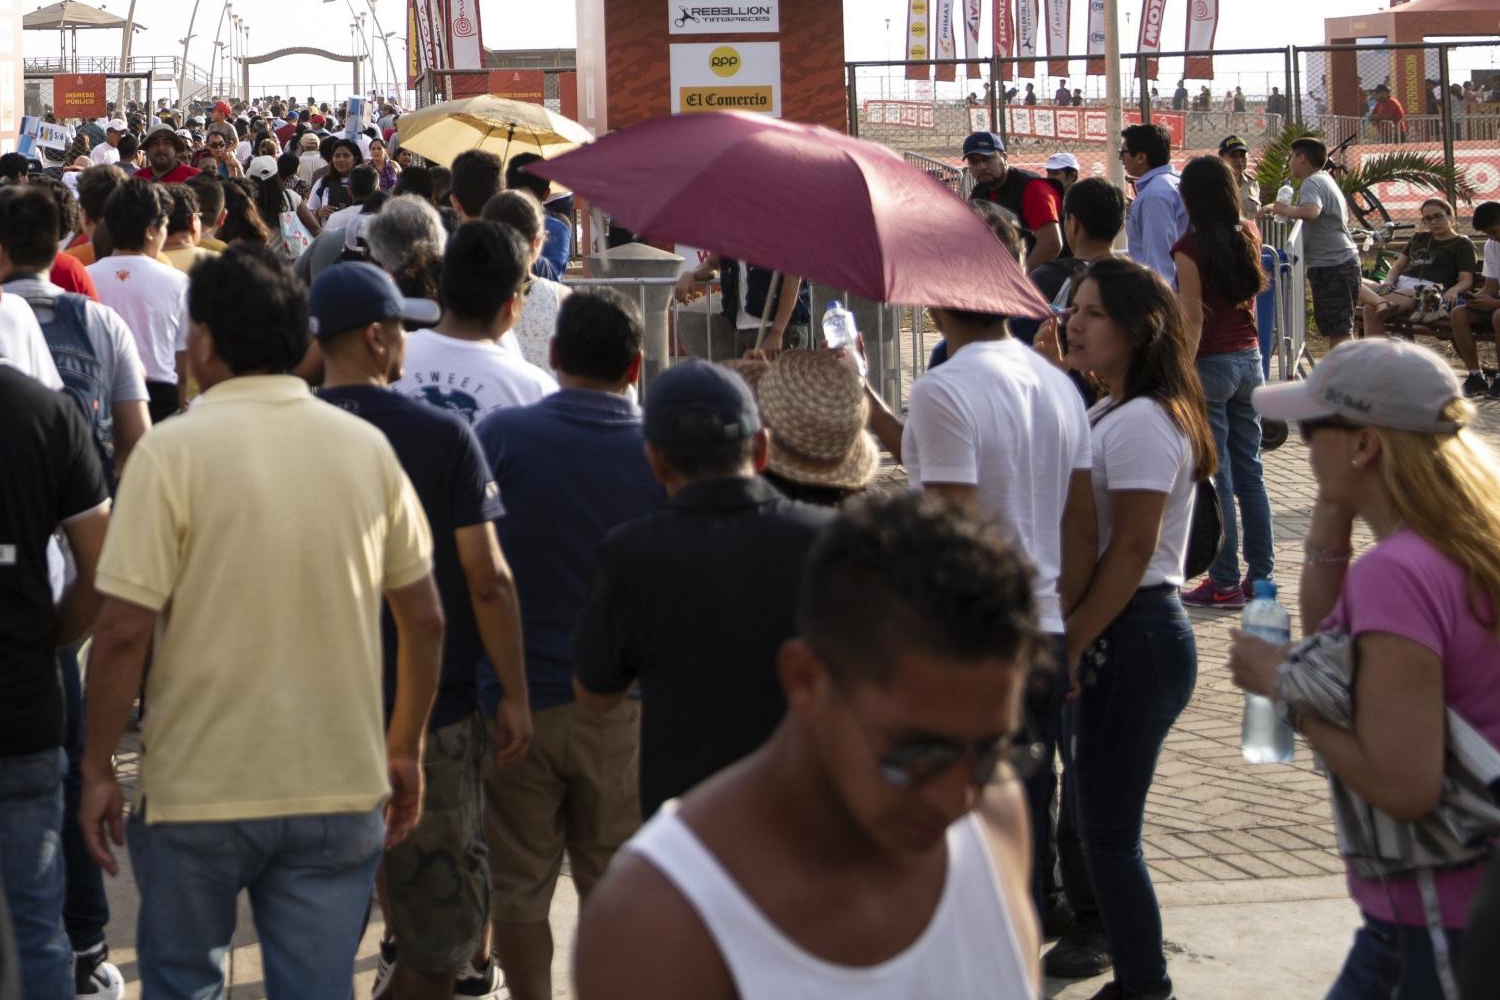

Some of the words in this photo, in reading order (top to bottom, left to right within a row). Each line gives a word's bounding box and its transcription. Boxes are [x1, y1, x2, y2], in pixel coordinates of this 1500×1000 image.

[691, 6, 770, 16] REBELLION
[686, 93, 703, 106] El
[705, 93, 767, 106] Comercio
[414, 370, 484, 394] SWEET
